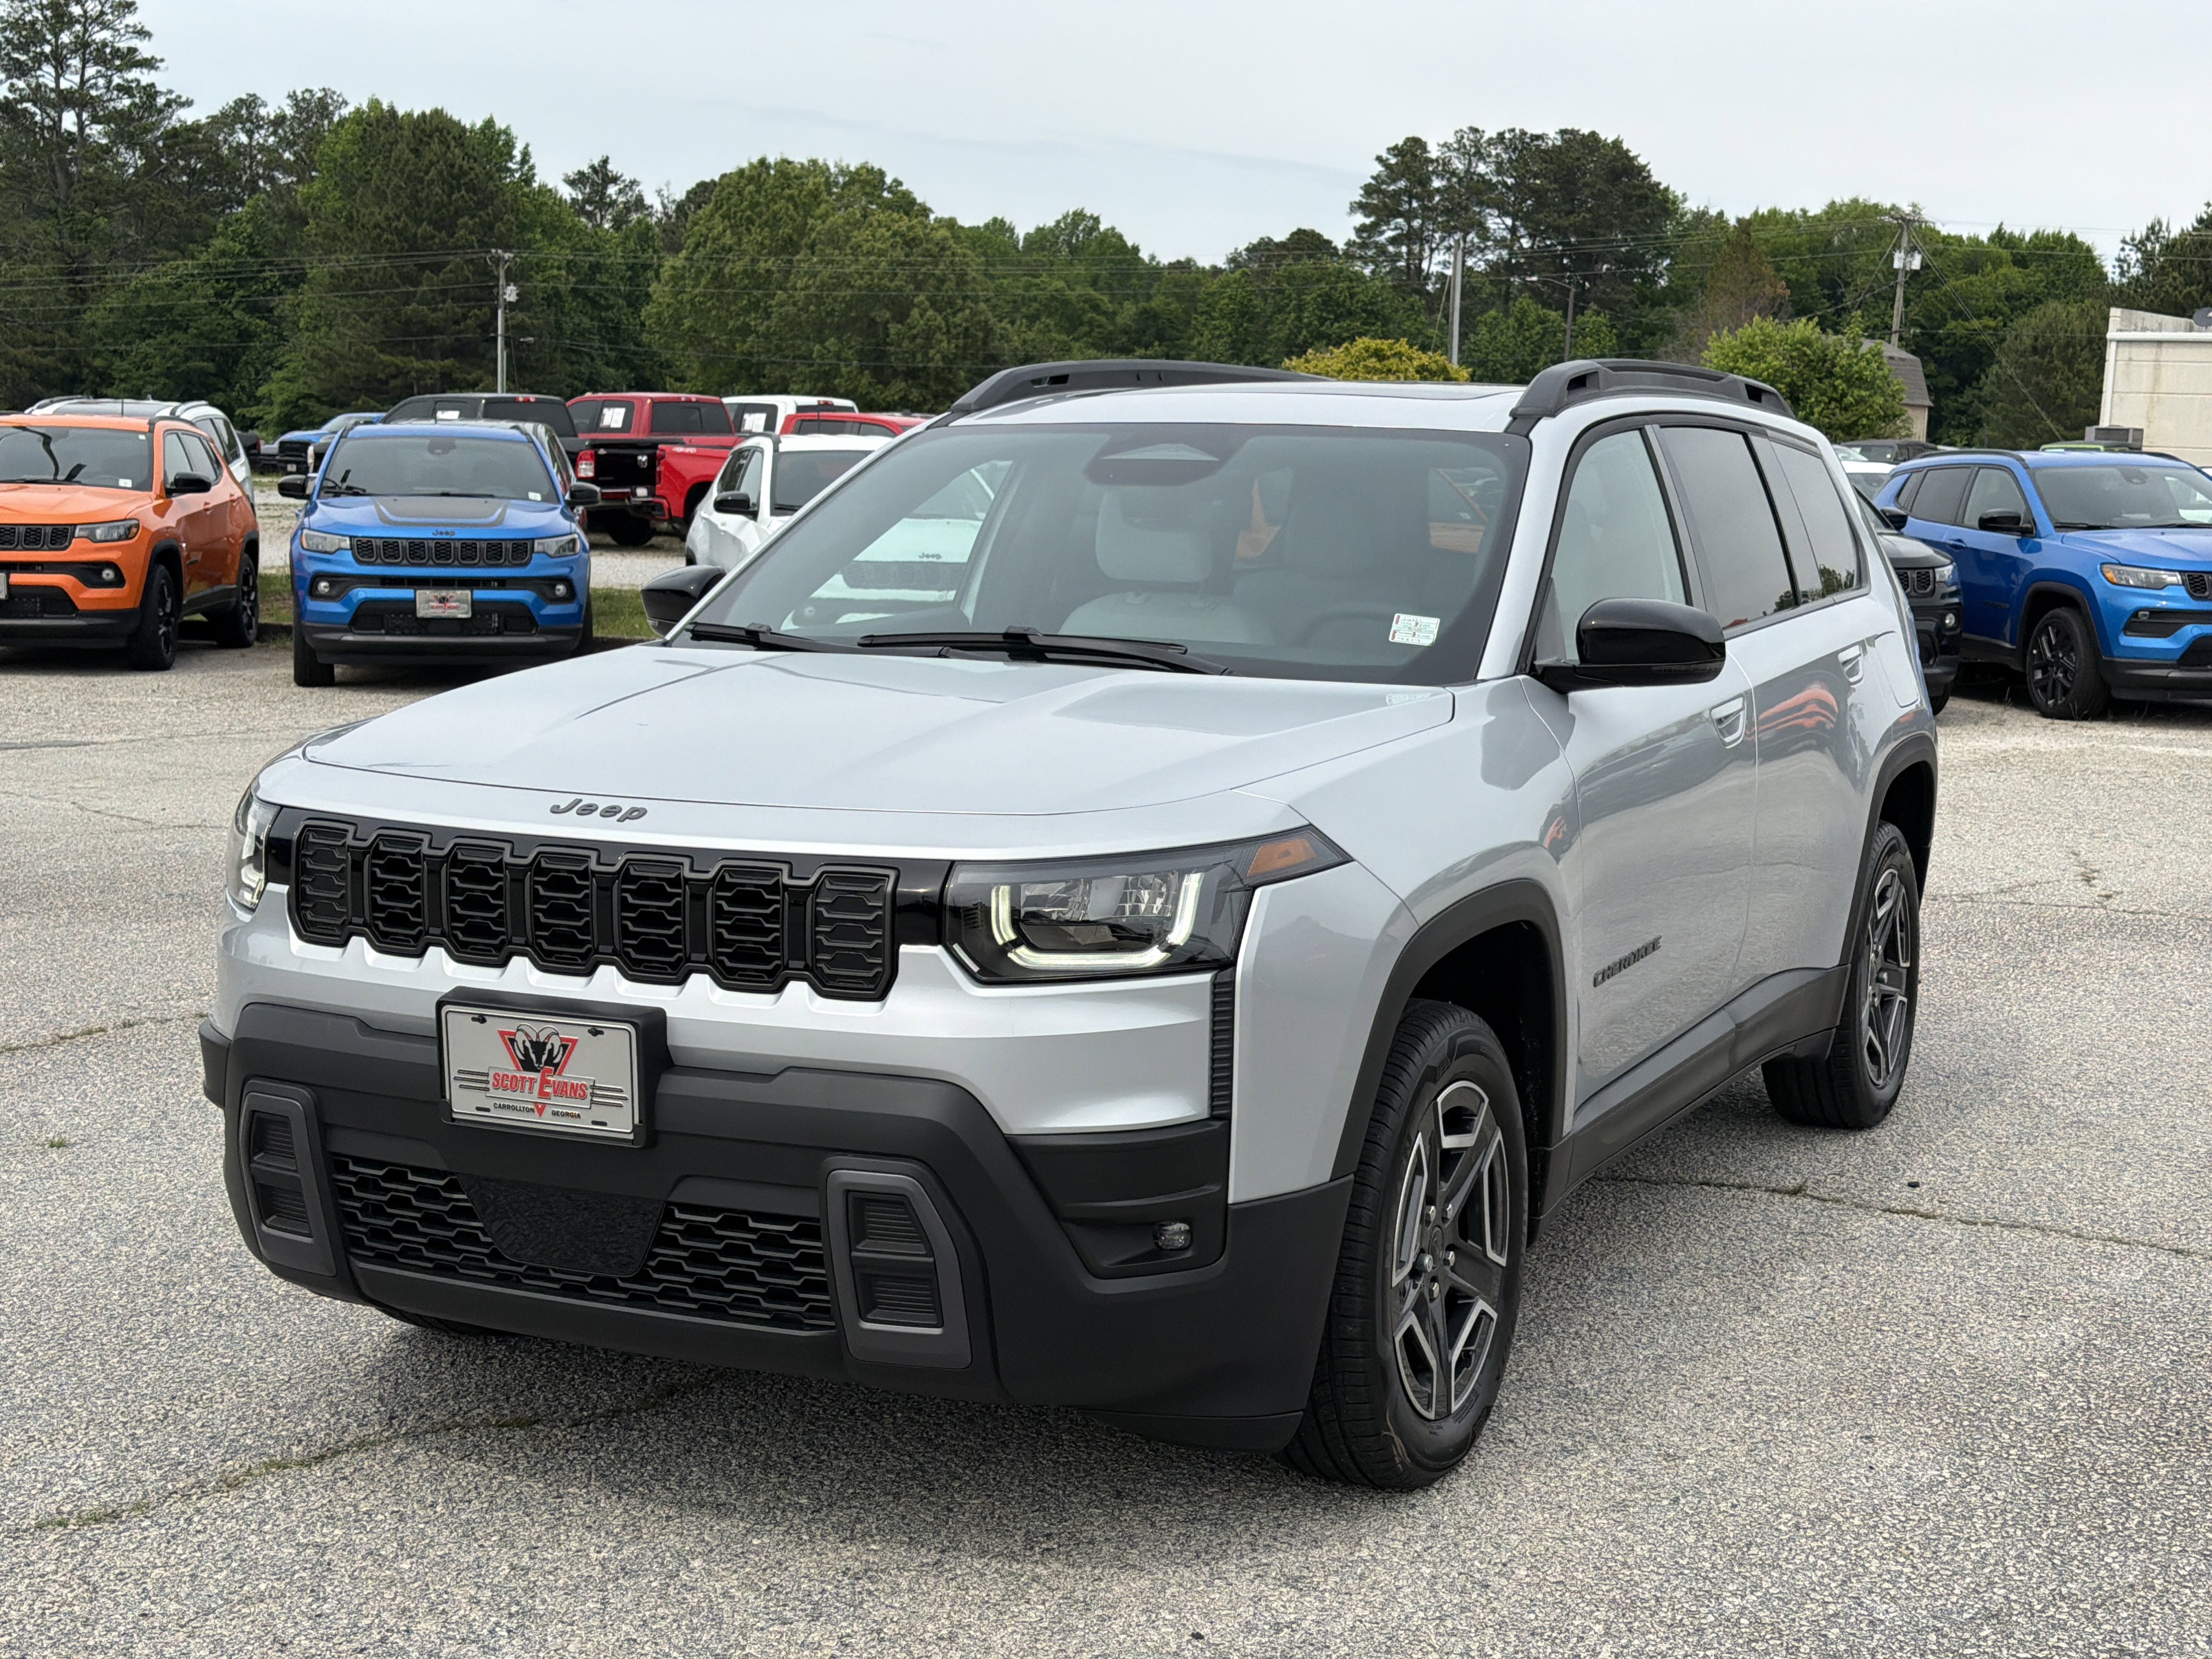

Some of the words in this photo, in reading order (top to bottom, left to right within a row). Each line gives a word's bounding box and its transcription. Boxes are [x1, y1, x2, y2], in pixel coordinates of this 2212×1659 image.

[918, 552, 941, 560] Jeep
[550, 798, 647, 822] Jeep
[1593, 935, 1662, 988] CHEROKEE
[492, 1072, 536, 1093] SCOTT
[538, 1066, 588, 1100] EVANS
[493, 1102, 535, 1114] CARROLLTON
[551, 1109, 582, 1120] GEORGIA
